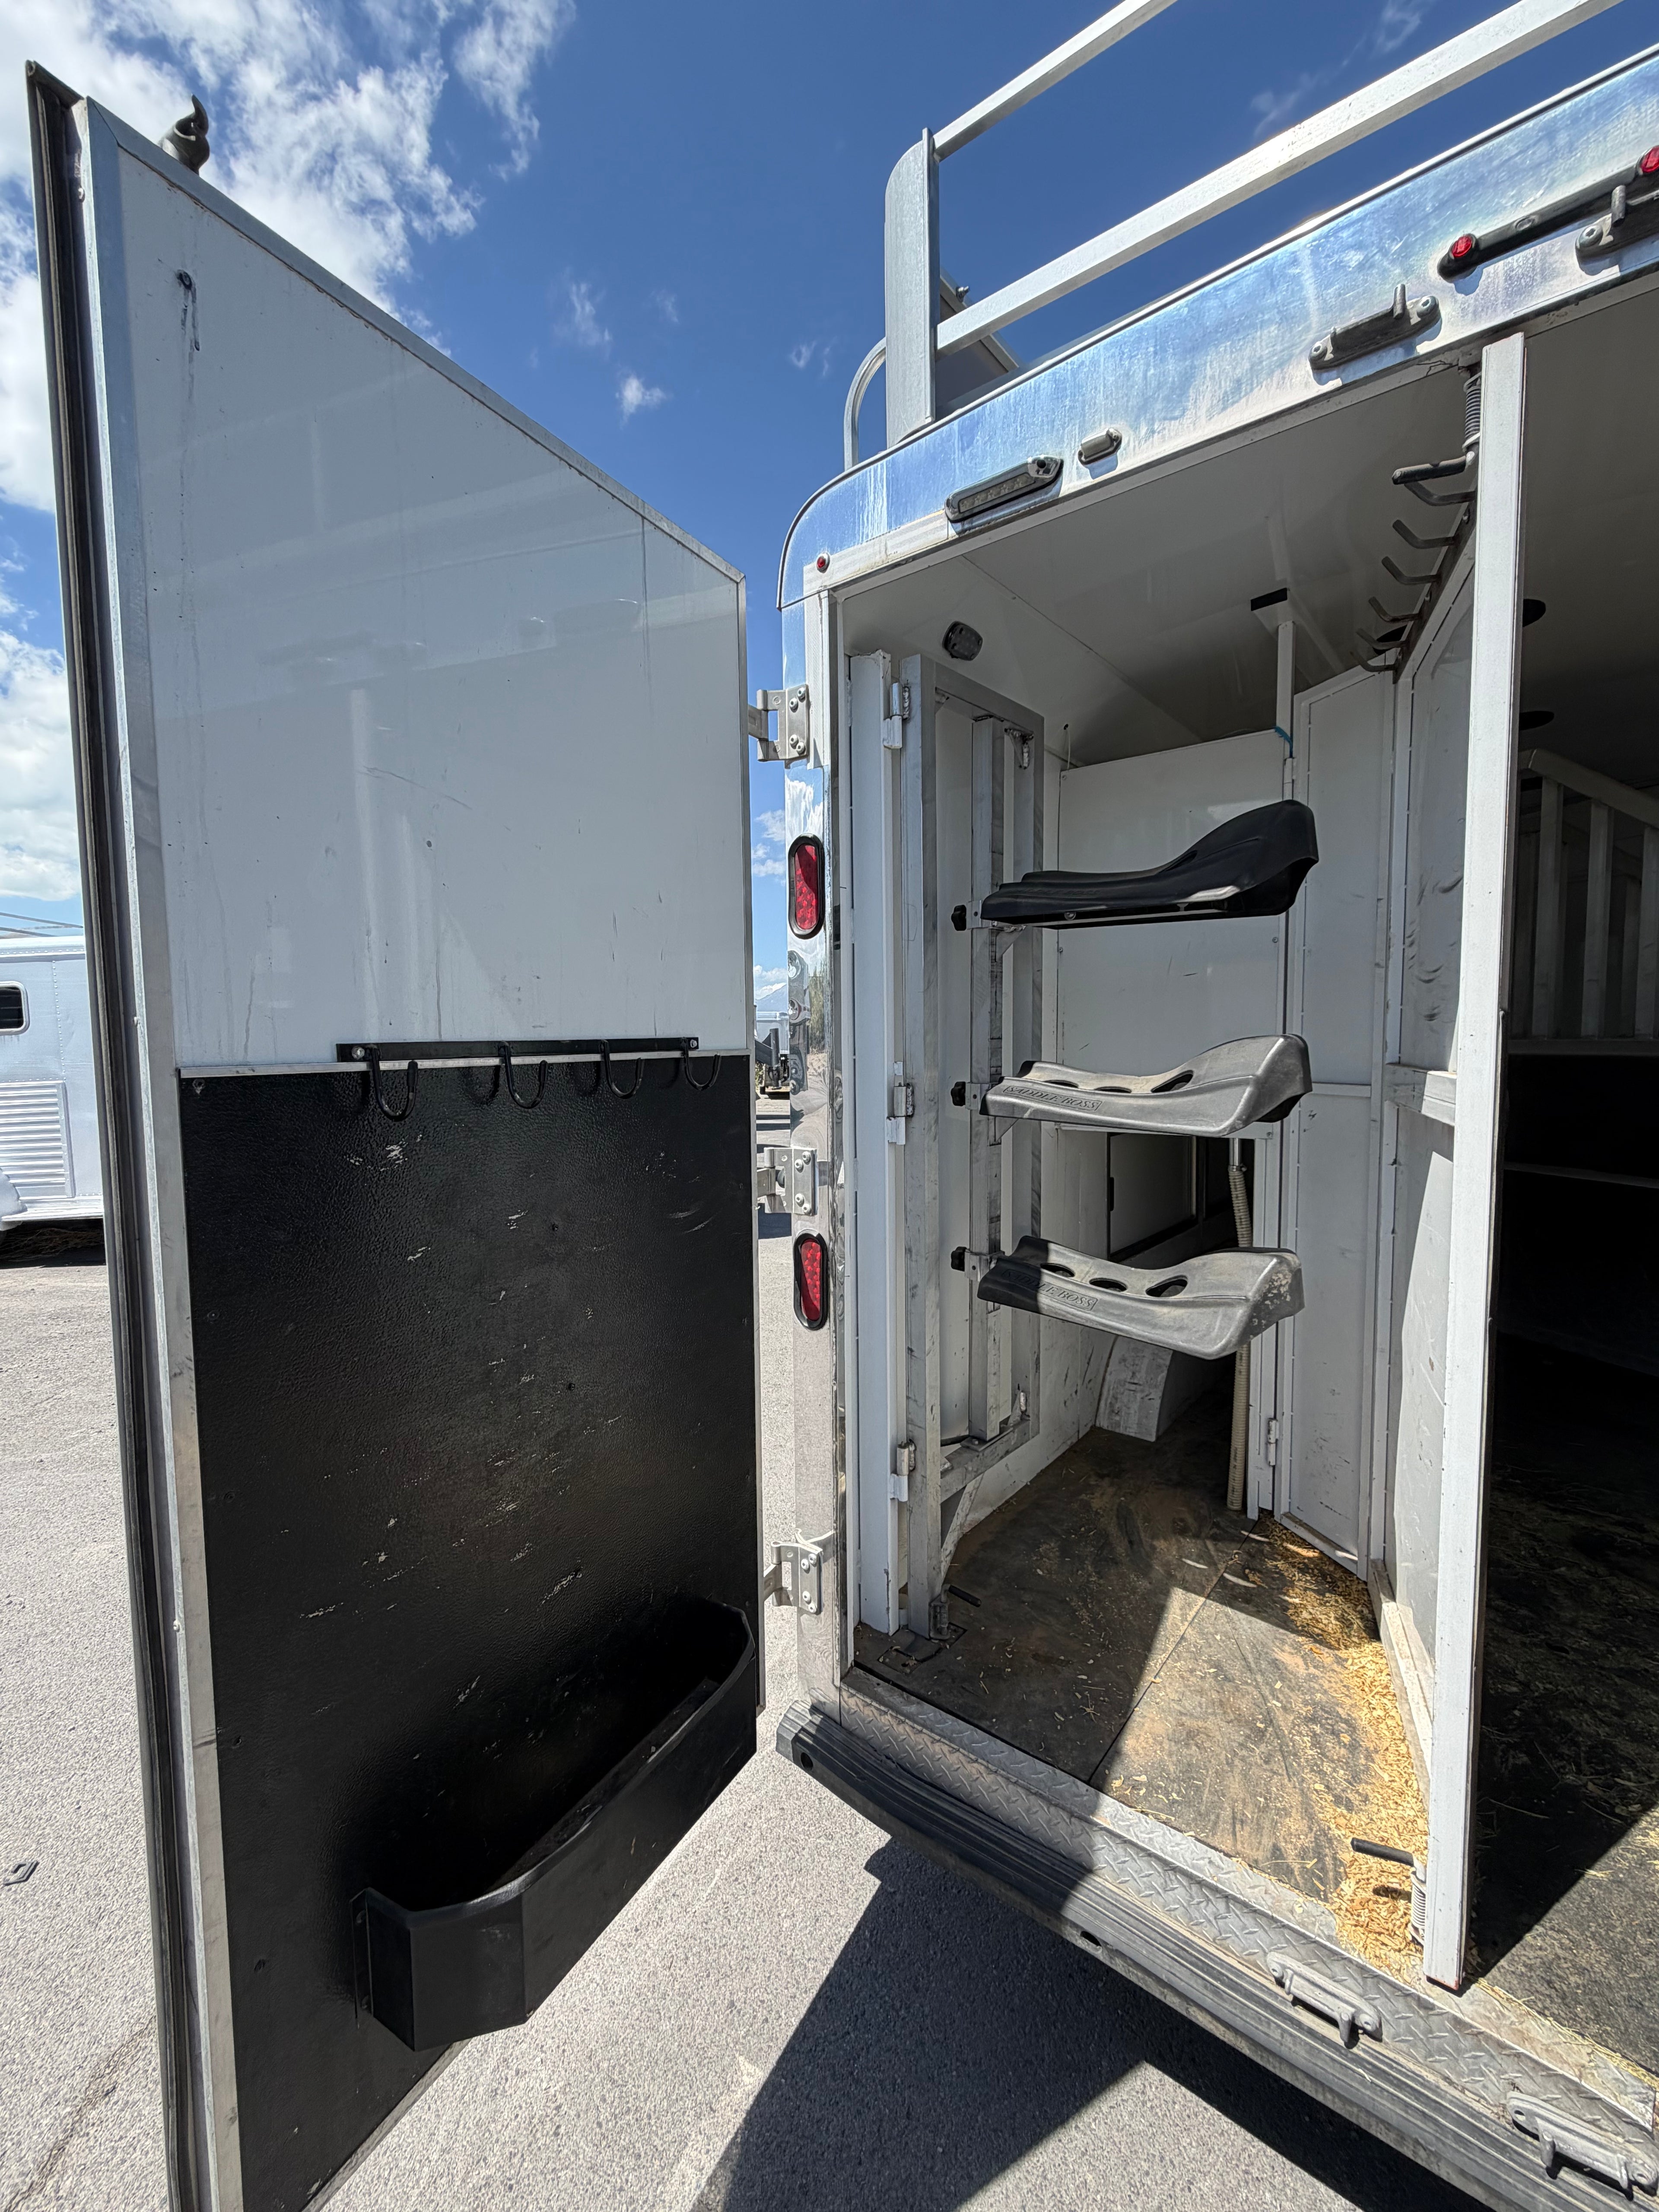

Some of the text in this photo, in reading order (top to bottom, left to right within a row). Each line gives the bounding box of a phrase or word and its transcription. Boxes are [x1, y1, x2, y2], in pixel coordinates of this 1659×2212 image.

[1007, 1086, 1099, 1108] SADDLE BOSS
[1058, 1290, 1094, 1307] BOSS
